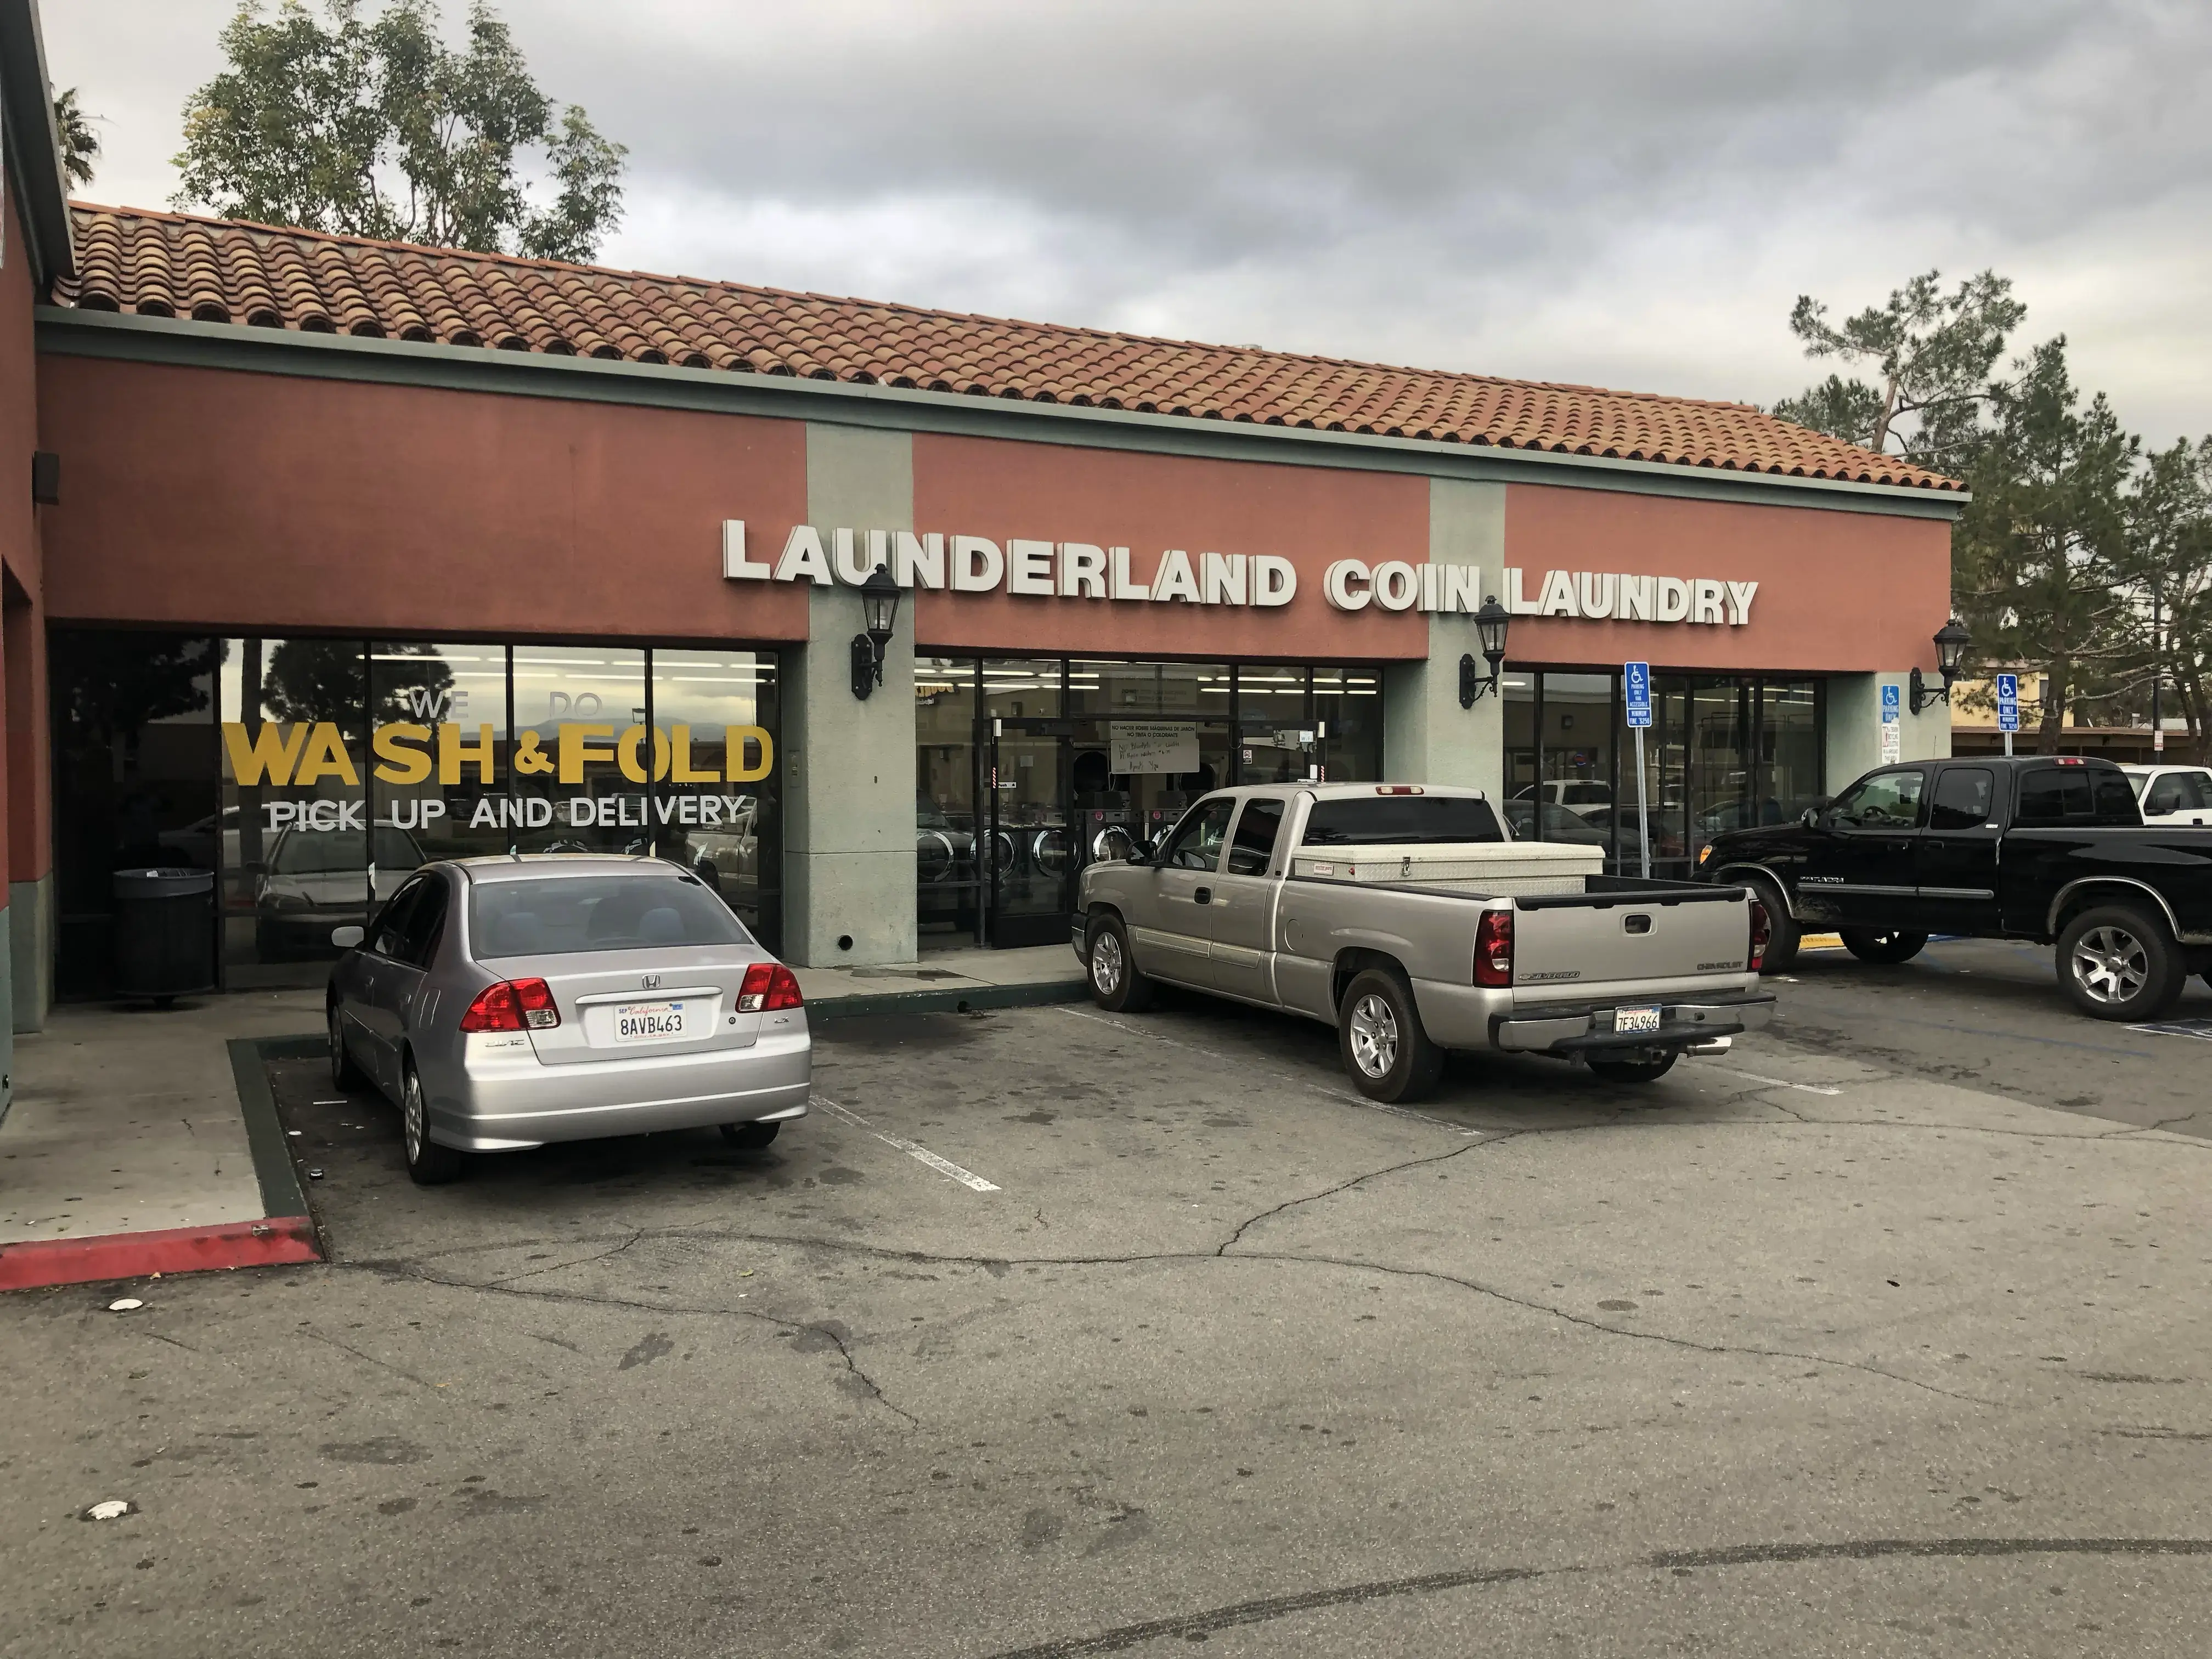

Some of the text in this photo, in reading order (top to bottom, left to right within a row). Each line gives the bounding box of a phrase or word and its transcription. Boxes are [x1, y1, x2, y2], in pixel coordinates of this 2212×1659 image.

[723, 519, 1758, 625] LAUNDERLAND COIN LAUNDRY
[409, 691, 602, 718] WE DO
[2000, 697, 2016, 706] PARKING
[2003, 706, 2013, 714] ONLY
[222, 722, 774, 786] WASH & FOLD
[269, 795, 747, 832] PICK UP AND DELIVERY
[1697, 961, 1743, 970] CHEVROLET
[1529, 971, 1581, 980] SILVERADO
[629, 1006, 673, 1017] California
[620, 1014, 682, 1035] 8AVB463
[1618, 1015, 1657, 1031] 7F34966
